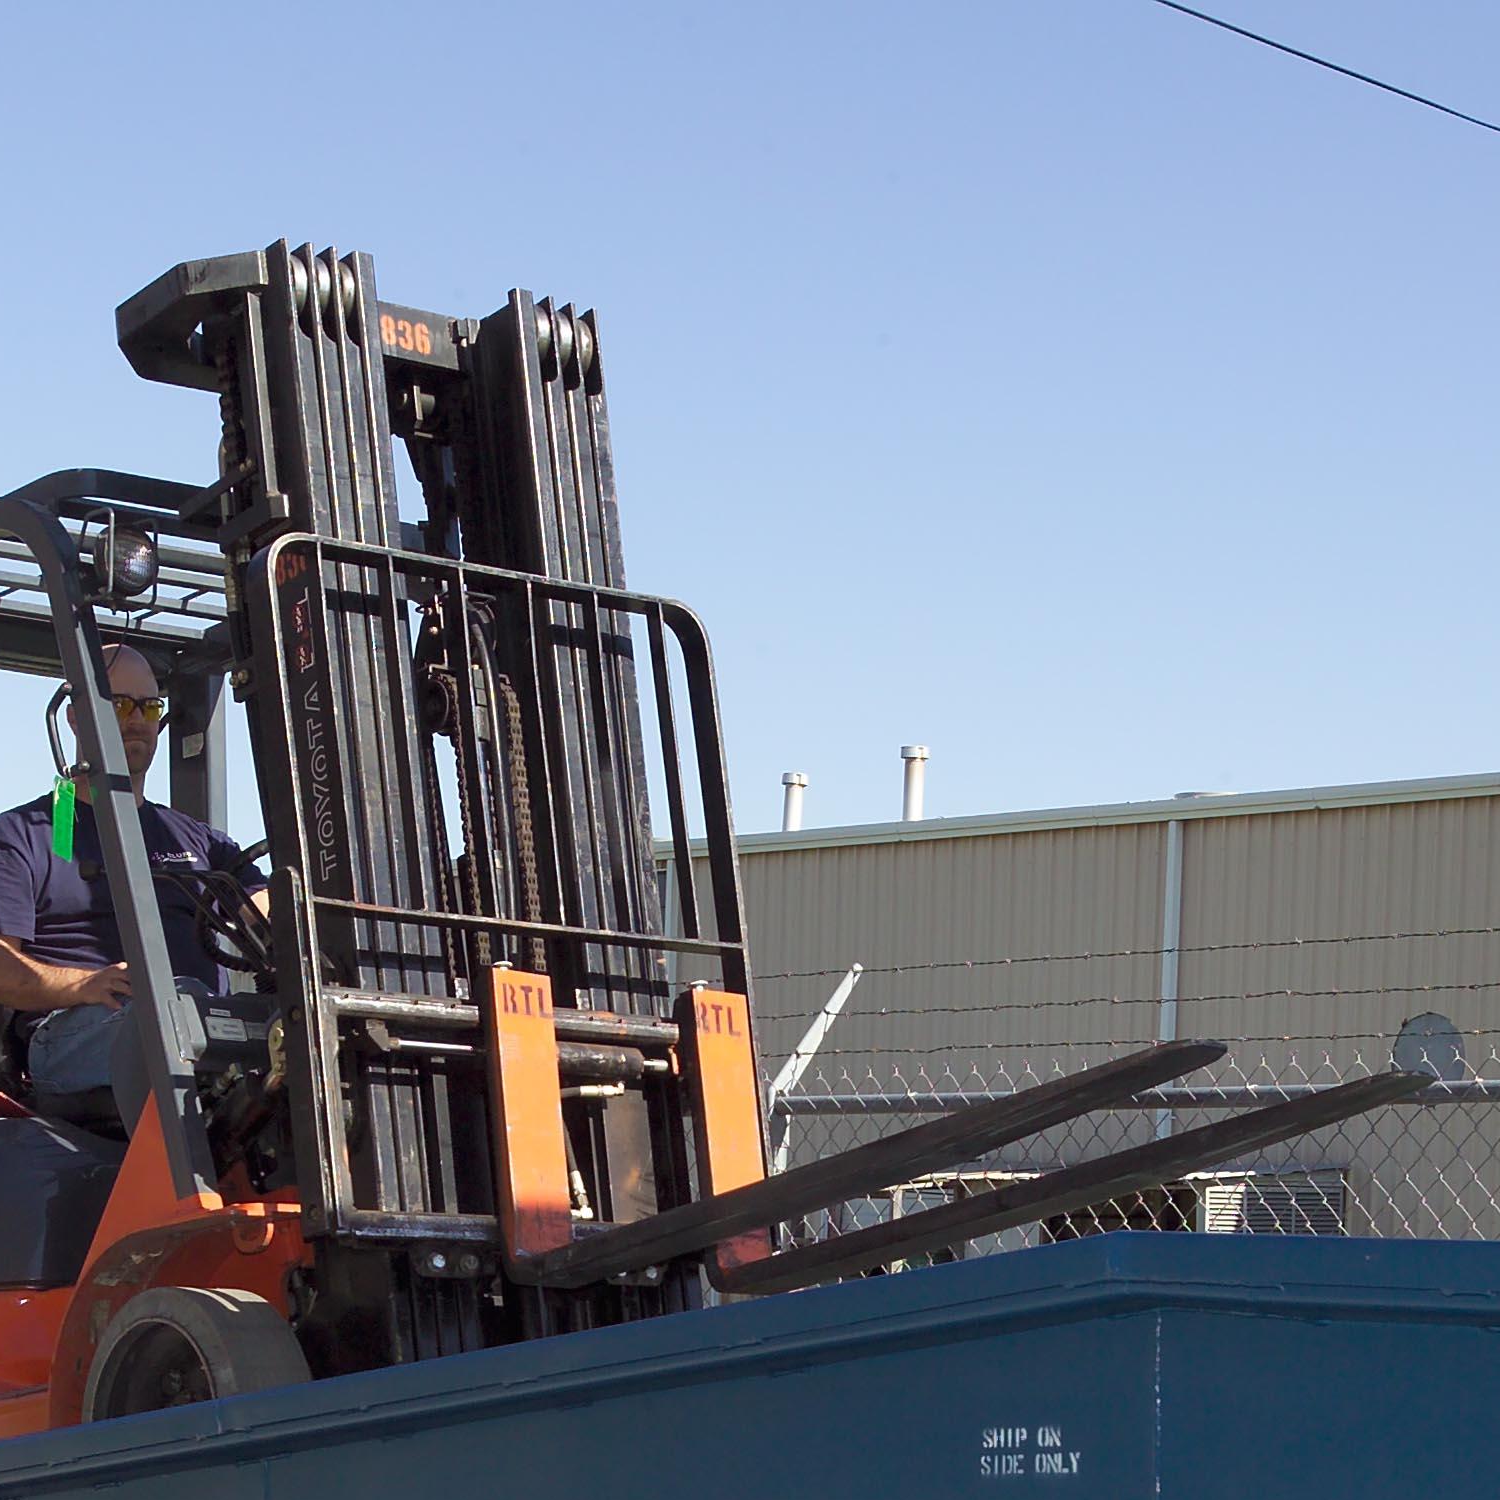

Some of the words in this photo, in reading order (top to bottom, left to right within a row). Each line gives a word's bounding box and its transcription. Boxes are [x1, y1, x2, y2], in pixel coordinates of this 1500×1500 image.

[380, 314, 431, 355] 836
[304, 681, 338, 882] TOYOTA
[502, 982, 551, 1017] RTL
[696, 1002, 741, 1037] RTL
[982, 1427, 1027, 1448] SHIP
[1037, 1426, 1062, 1447] ON
[980, 1454, 1025, 1475] SIDE
[1035, 1451, 1081, 1474] ONLY
